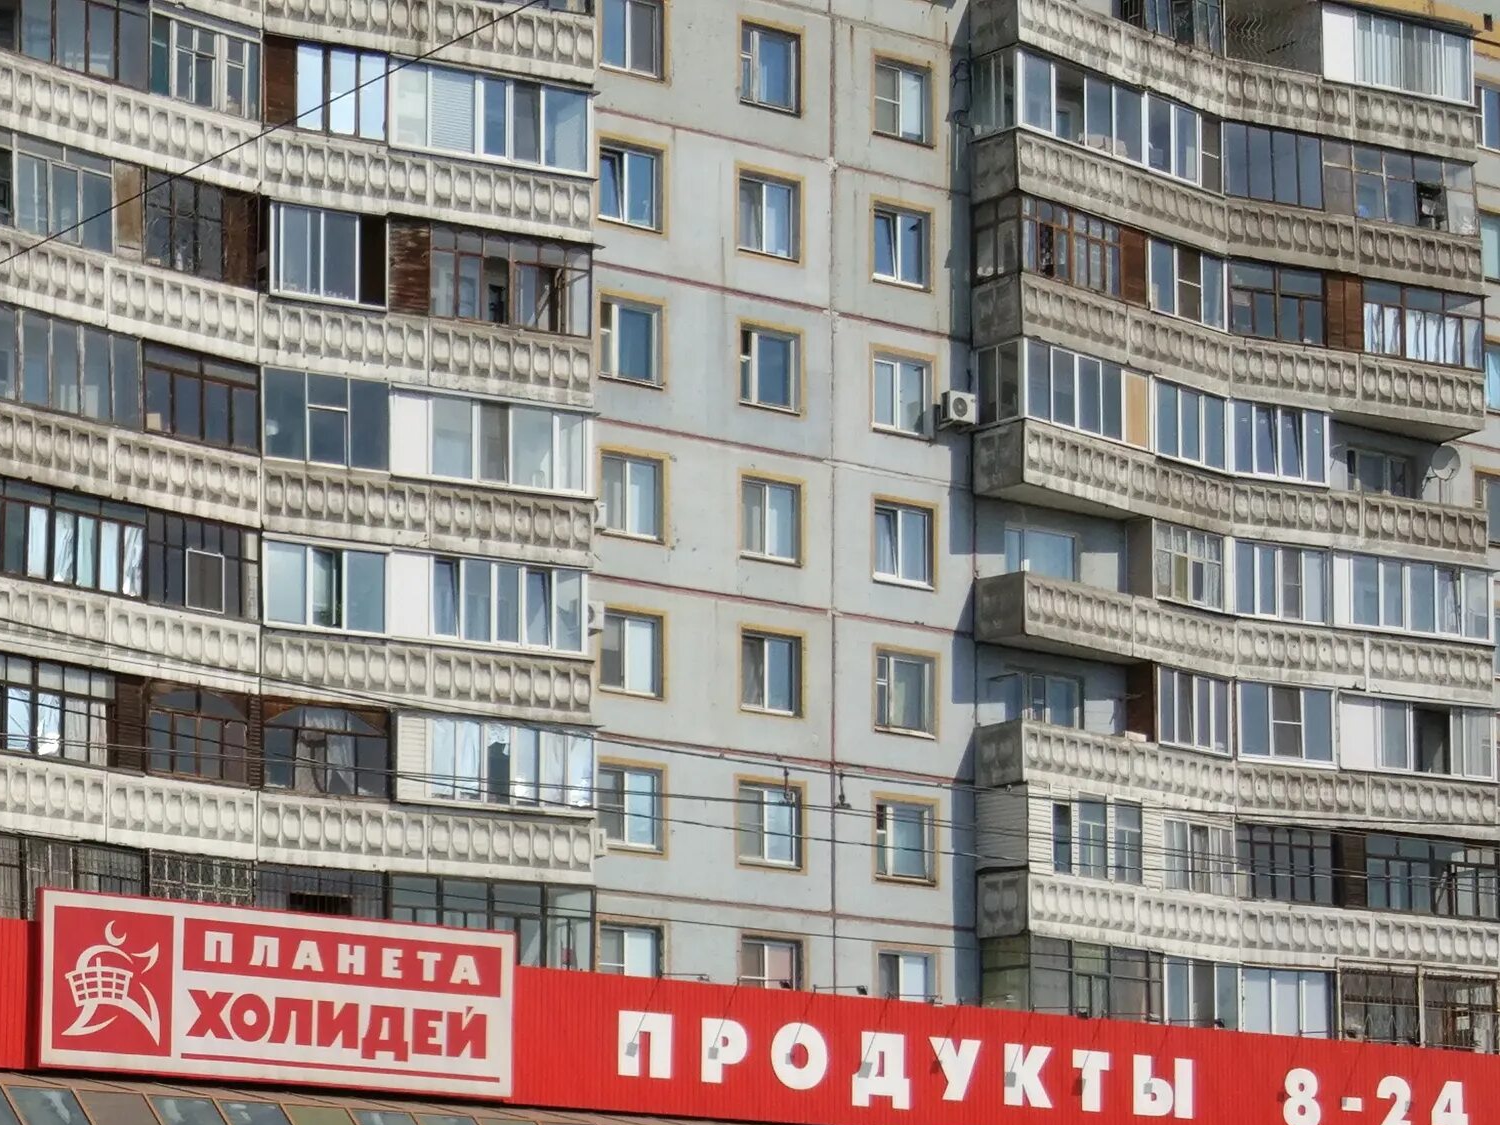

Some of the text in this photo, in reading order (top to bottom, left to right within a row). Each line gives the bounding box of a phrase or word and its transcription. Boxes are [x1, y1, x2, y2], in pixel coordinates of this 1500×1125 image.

[203, 930, 482, 986] ПЛАНЕТА
[185, 988, 488, 1063] ХОЛИДЕЙ
[617, 1010, 1195, 1120] ПРОДУКТЫ
